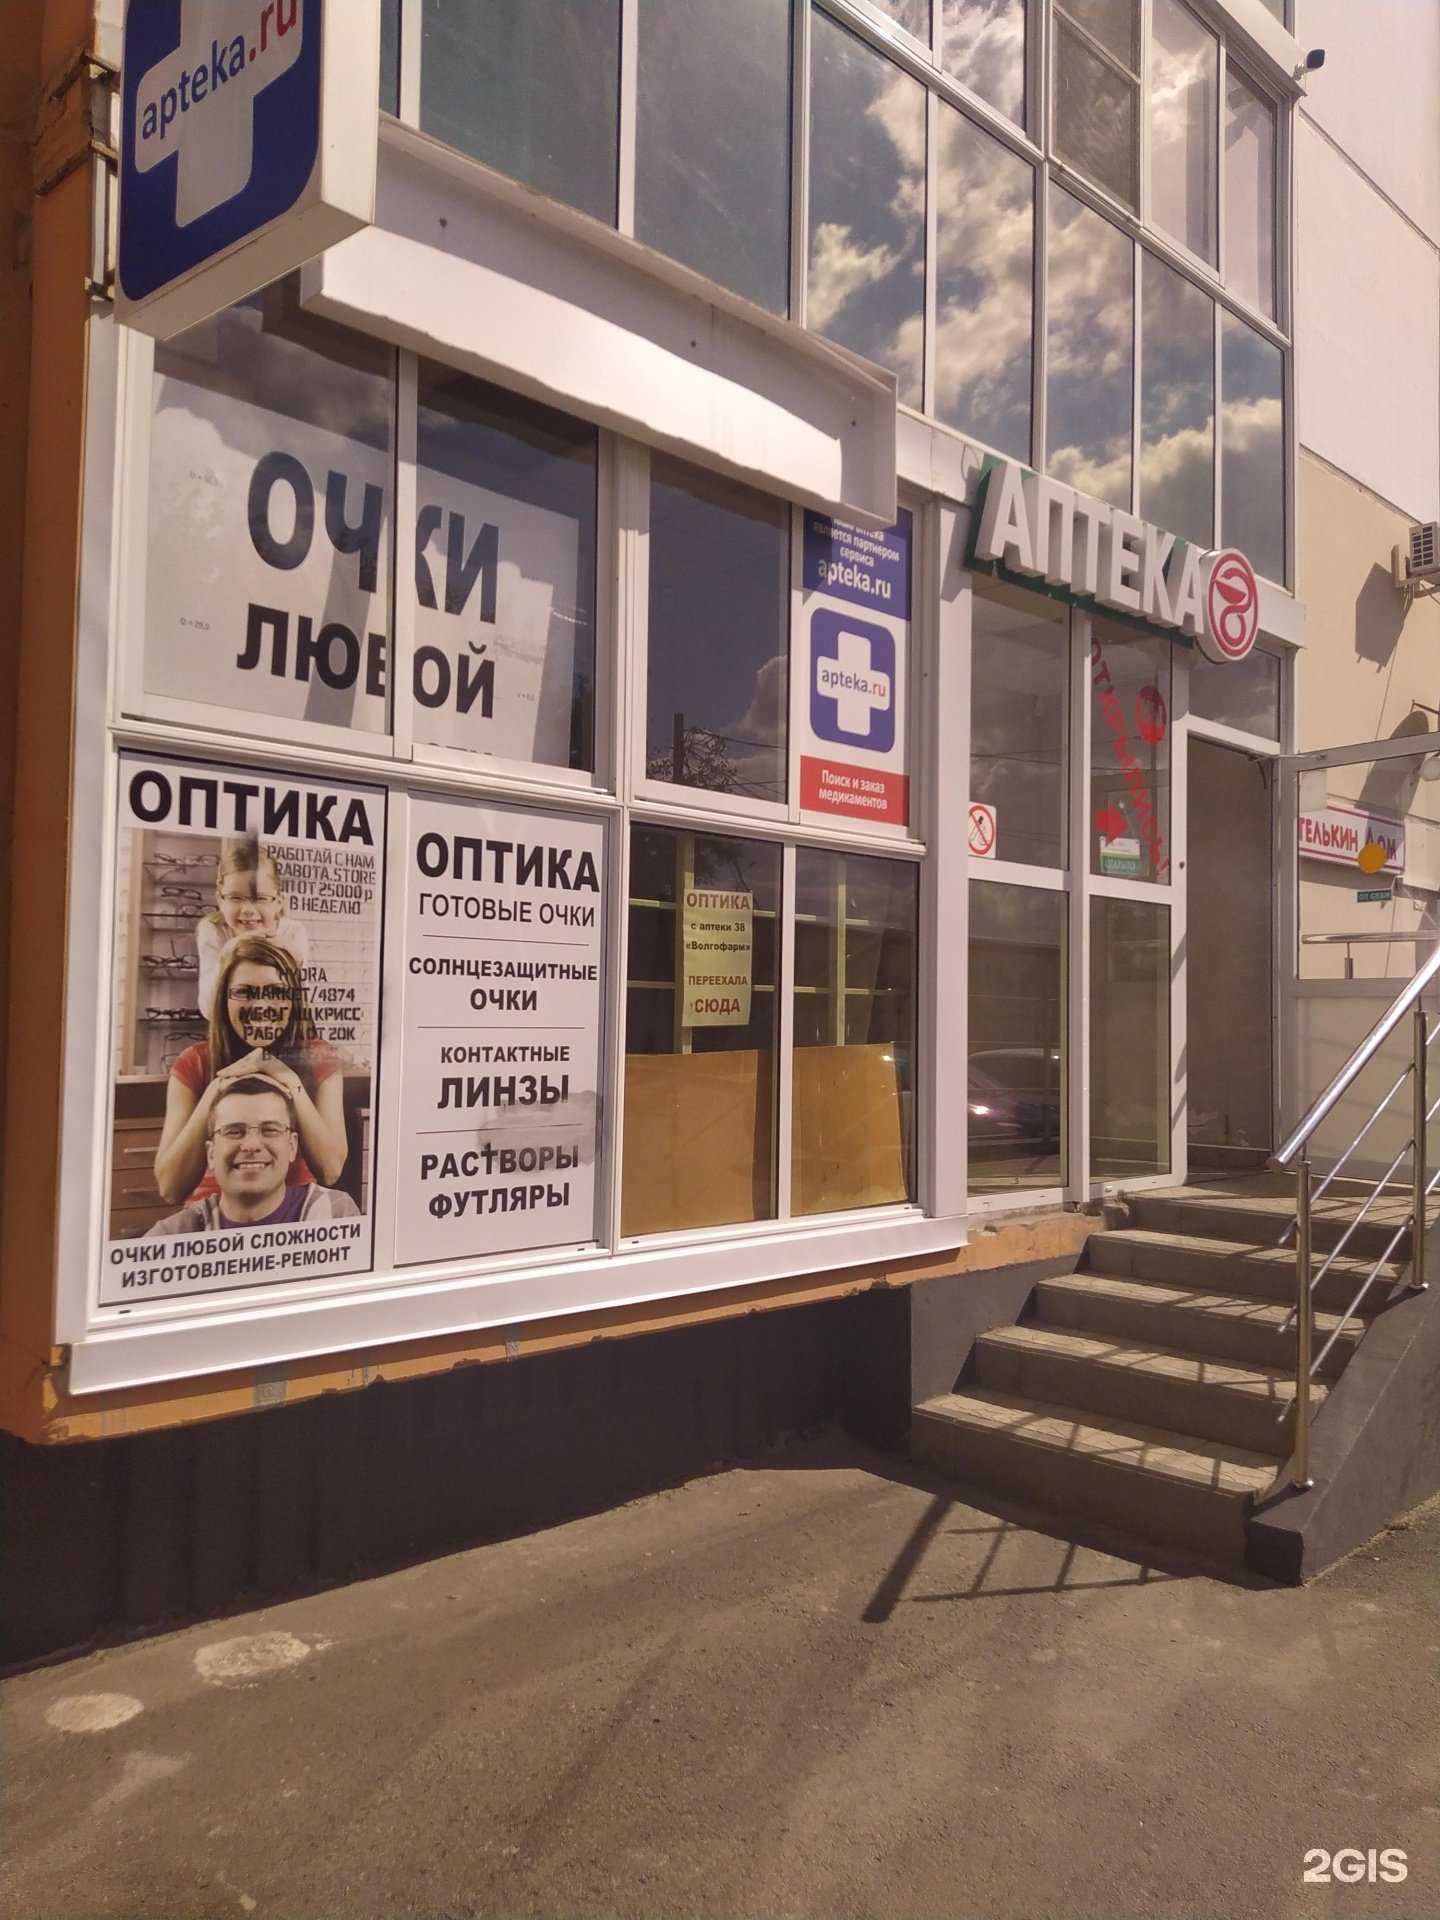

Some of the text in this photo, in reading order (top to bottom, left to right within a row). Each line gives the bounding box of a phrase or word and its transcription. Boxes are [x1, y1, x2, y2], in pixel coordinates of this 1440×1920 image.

[142, 0, 298, 139] apteka.ru
[247, 450, 499, 625] ОЧКИ
[980, 461, 1203, 636] АПТЕКА
[840, 547, 874, 567] сервиса
[818, 559, 891, 599] apteka.ru
[822, 669, 886, 697] apteka.ru
[821, 769, 885, 793] Поиск и заказ
[129, 770, 374, 846] ОПТИКА
[819, 788, 888, 810] медикаментов
[267, 845, 332, 864] РАБОТАЙ
[346, 853, 375, 869] НАМ
[416, 832, 600, 893] ОПТИКА
[319, 882, 362, 899] 25000
[686, 892, 750, 910] ОПТИКА
[302, 897, 361, 915] НЕДЕЛЮ
[419, 893, 595, 927] ГОТОВЫЕ ОЧКИ
[699, 923, 732, 931] аптеки
[685, 941, 750, 952] «Волгофарм»
[409, 957, 597, 981] СОЛНЦЕЗАЩИТНЫЕ
[688, 975, 748, 986] ПЕРЕЕХАЛА
[470, 988, 538, 1011] ОЧКИ
[694, 998, 741, 1015] СЮДА
[440, 1046, 570, 1064] КОНТАКТНЫЕ
[437, 1074, 569, 1109] ЛИНЗЫ
[420, 1144, 579, 1180] РАСТВОРЫ
[428, 1182, 570, 1219] ФУТЛЯРЫ
[110, 1223, 361, 1265] ОЧКИ ЛЮБОЙ СЛОЖНОСТИ
[121, 1246, 351, 1288] ИЗГОТОВЛЕНИЕ-РЕМОНТ
